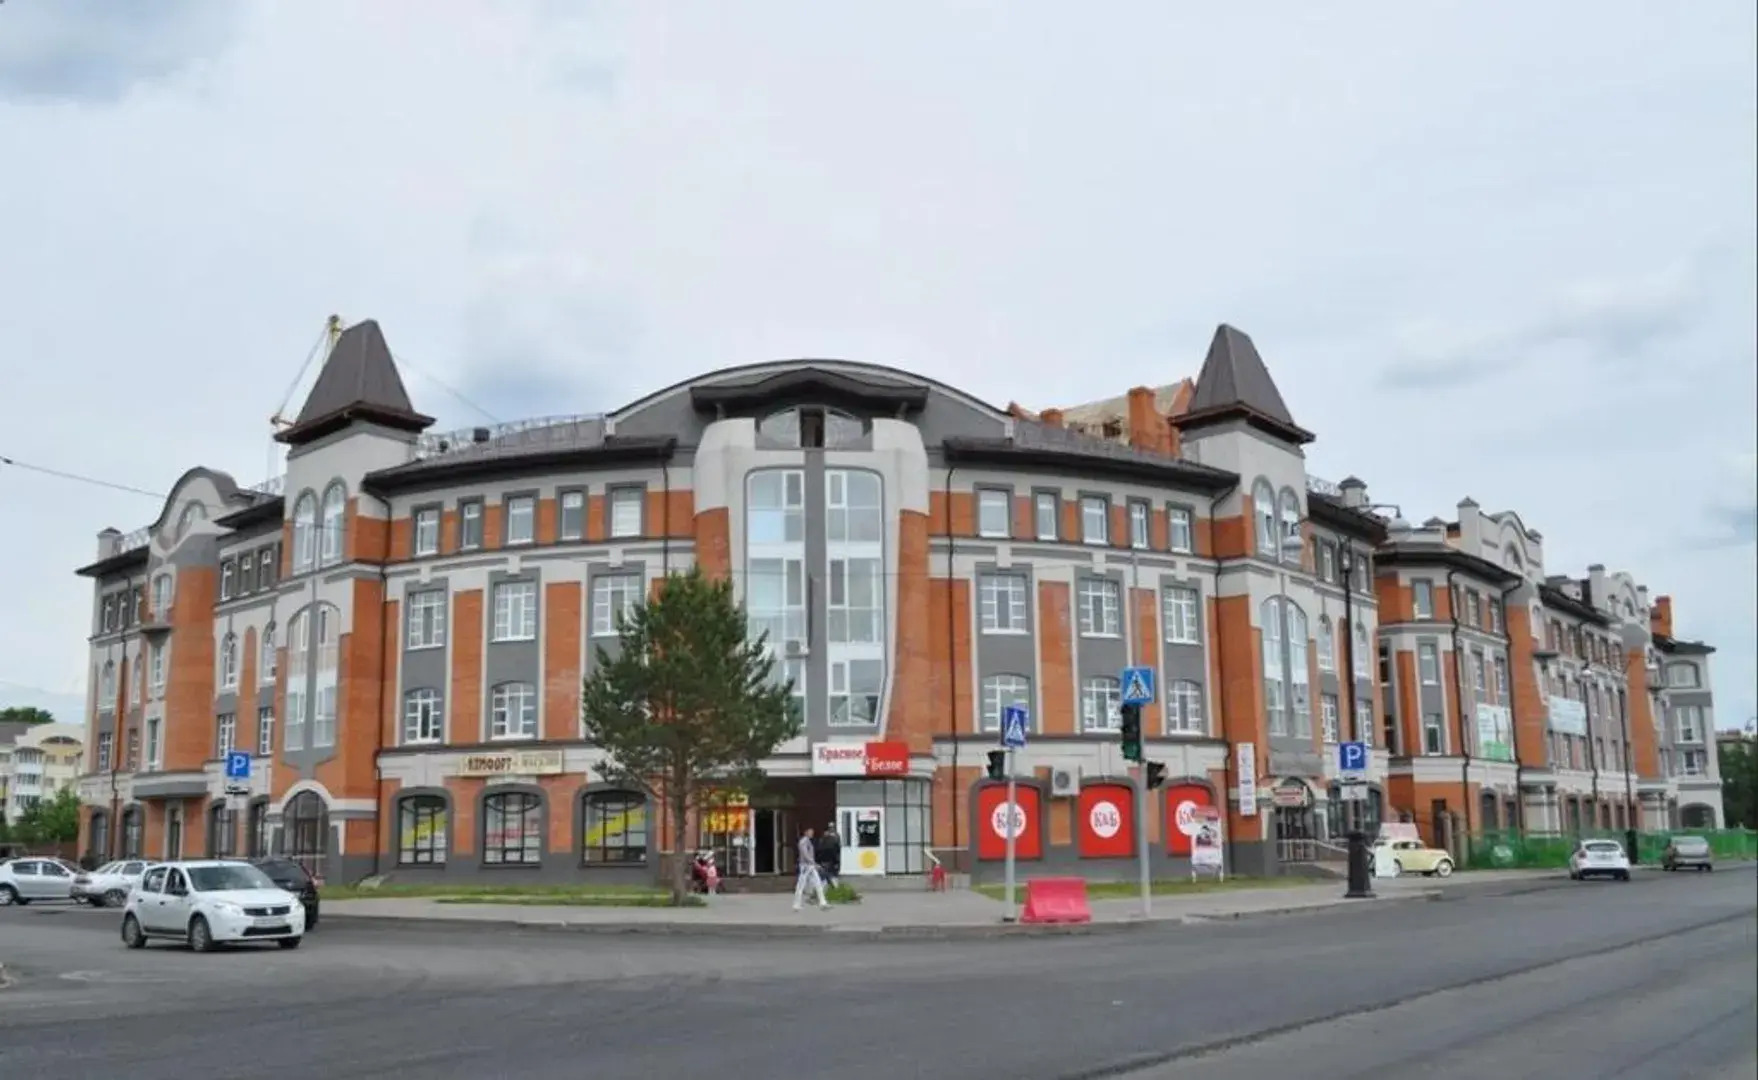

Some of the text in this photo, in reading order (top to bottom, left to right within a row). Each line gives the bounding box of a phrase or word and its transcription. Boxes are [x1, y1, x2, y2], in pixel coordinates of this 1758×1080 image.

[818, 746, 862, 763] Красное
[1346, 745, 1361, 767] P
[232, 755, 246, 775] P
[871, 757, 903, 771] Белое
